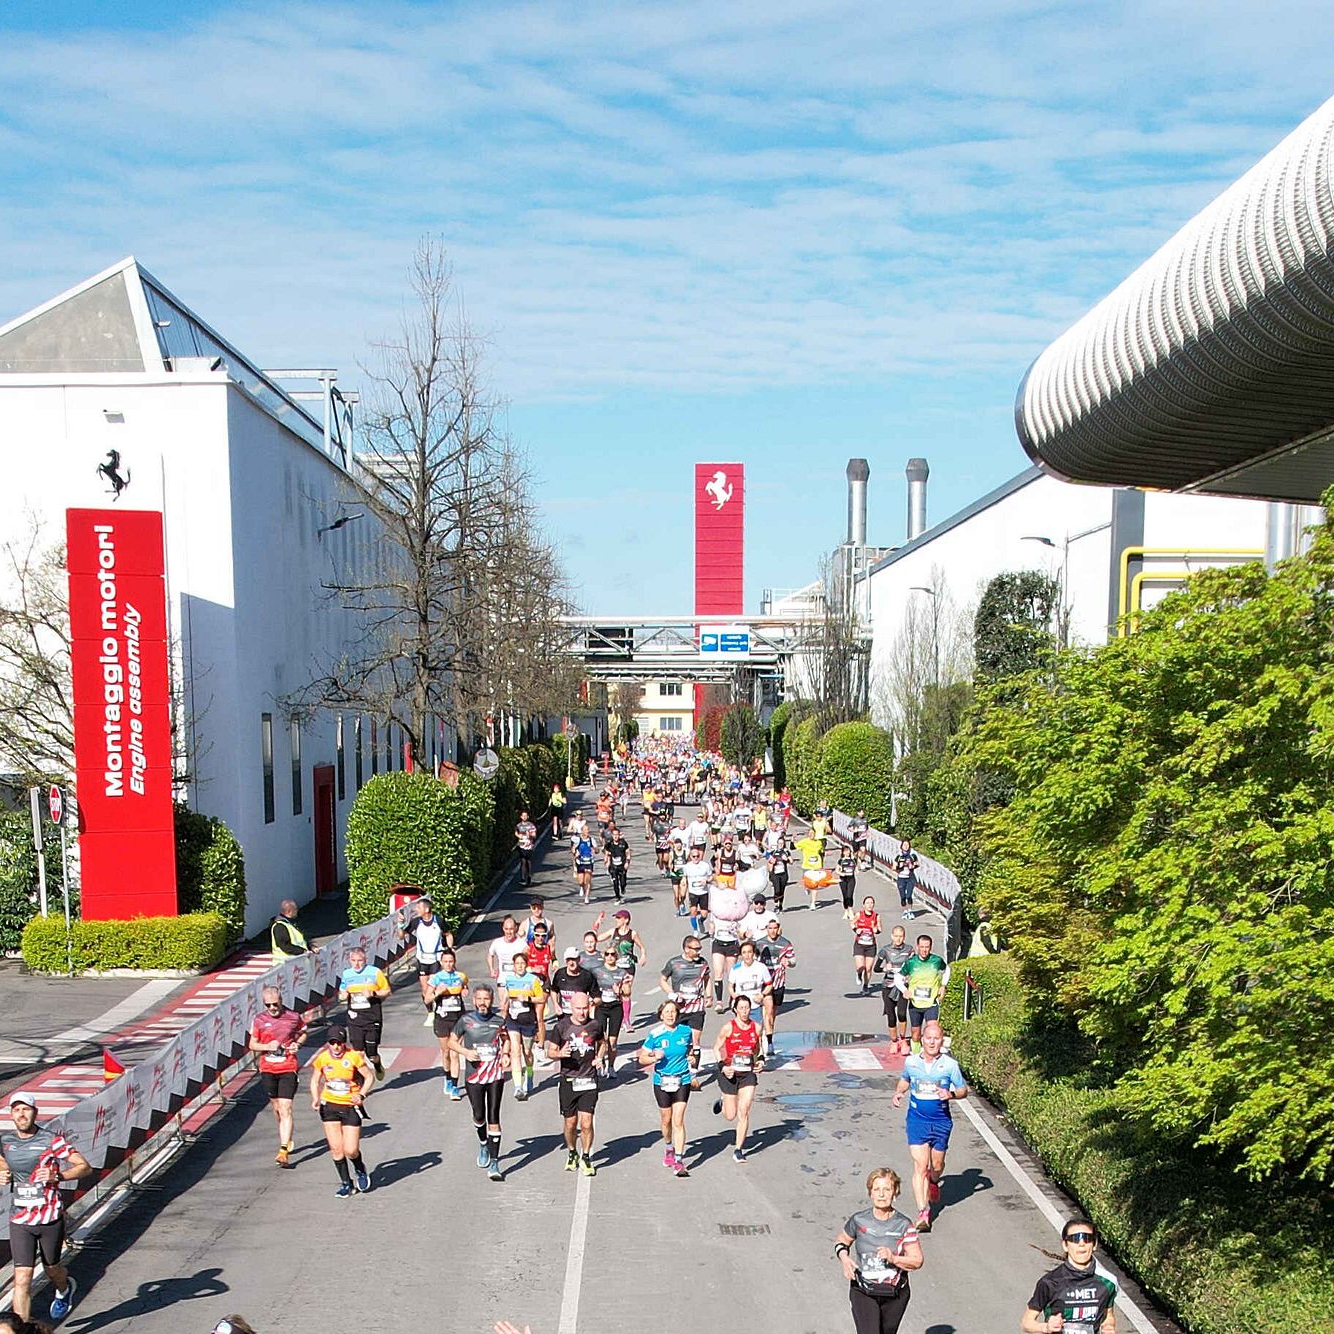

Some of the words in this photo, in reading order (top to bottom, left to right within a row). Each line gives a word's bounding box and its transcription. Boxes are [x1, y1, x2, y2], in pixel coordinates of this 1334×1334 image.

[94, 525, 117, 630] motori
[124, 602, 142, 715] assembly
[99, 637, 124, 796] Montaggio
[128, 719, 146, 795] Engine
